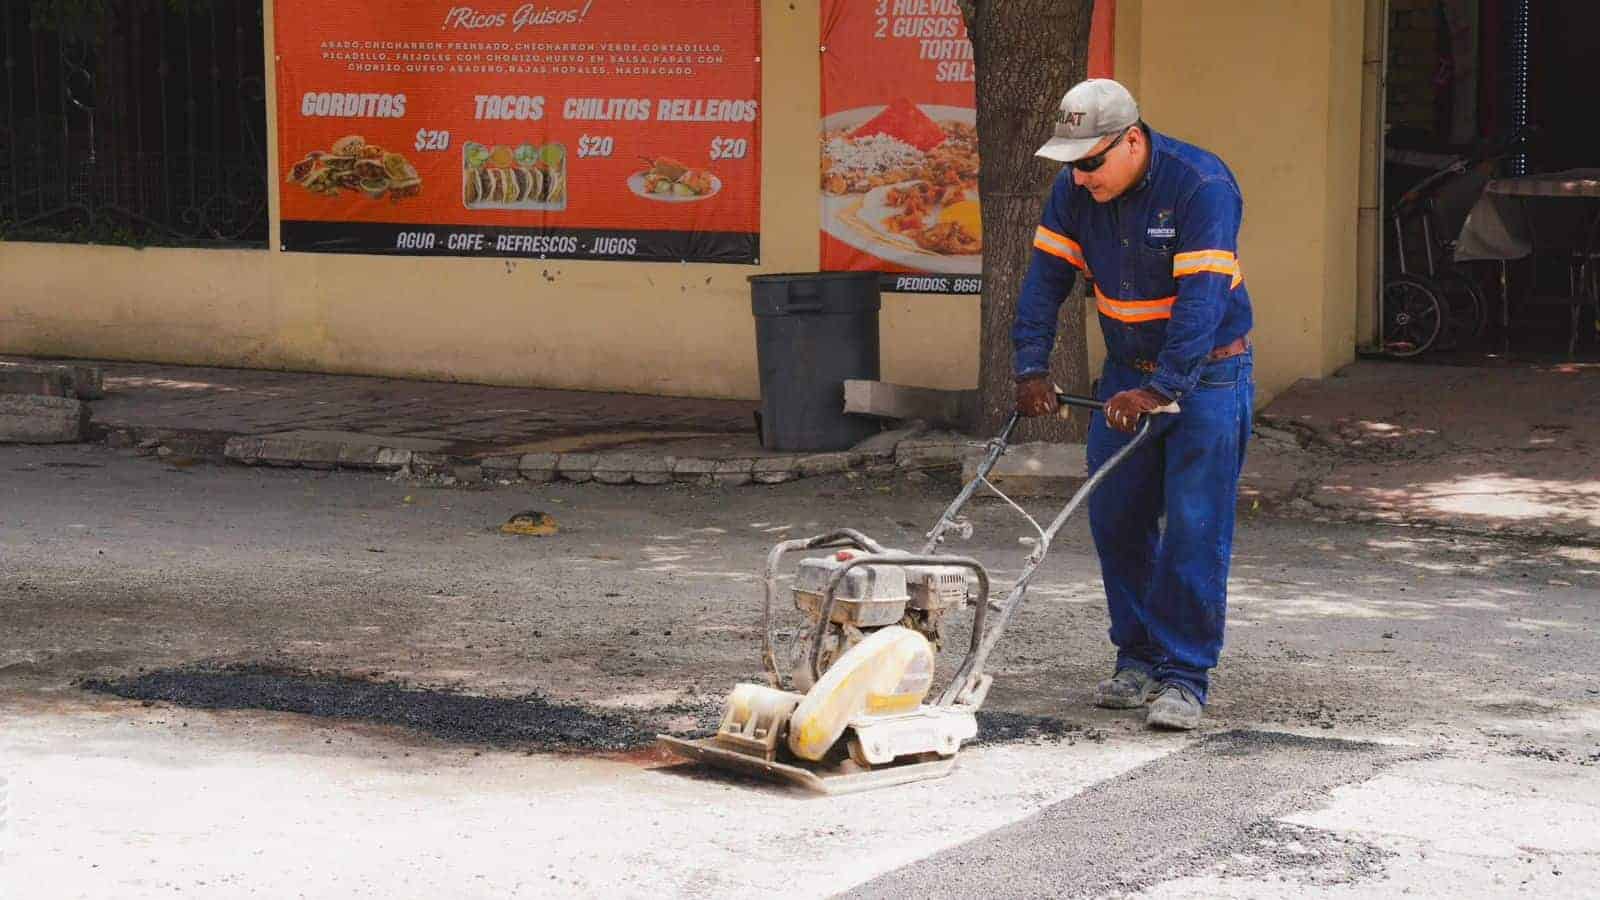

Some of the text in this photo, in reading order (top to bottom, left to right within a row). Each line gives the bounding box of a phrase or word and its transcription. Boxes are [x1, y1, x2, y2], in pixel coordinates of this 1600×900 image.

[874, 0, 961, 16] 3 HUEVOS
[874, 17, 888, 38] 2
[893, 17, 959, 38] GUISOS
[456, 54, 481, 62] CON
[590, 55, 605, 63] EN
[697, 55, 723, 64] CON
[302, 92, 407, 118] GORDITAS
[474, 95, 545, 120] TACOS
[563, 98, 758, 122] CHILITOS RELLENOS
[414, 128, 449, 151] $20
[577, 134, 614, 158] $20
[710, 136, 747, 160] $20
[397, 232, 637, 255] AGUA CAFE REFRESCOS JUGOS
[896, 277, 982, 293] PEDIDOS: 8661
